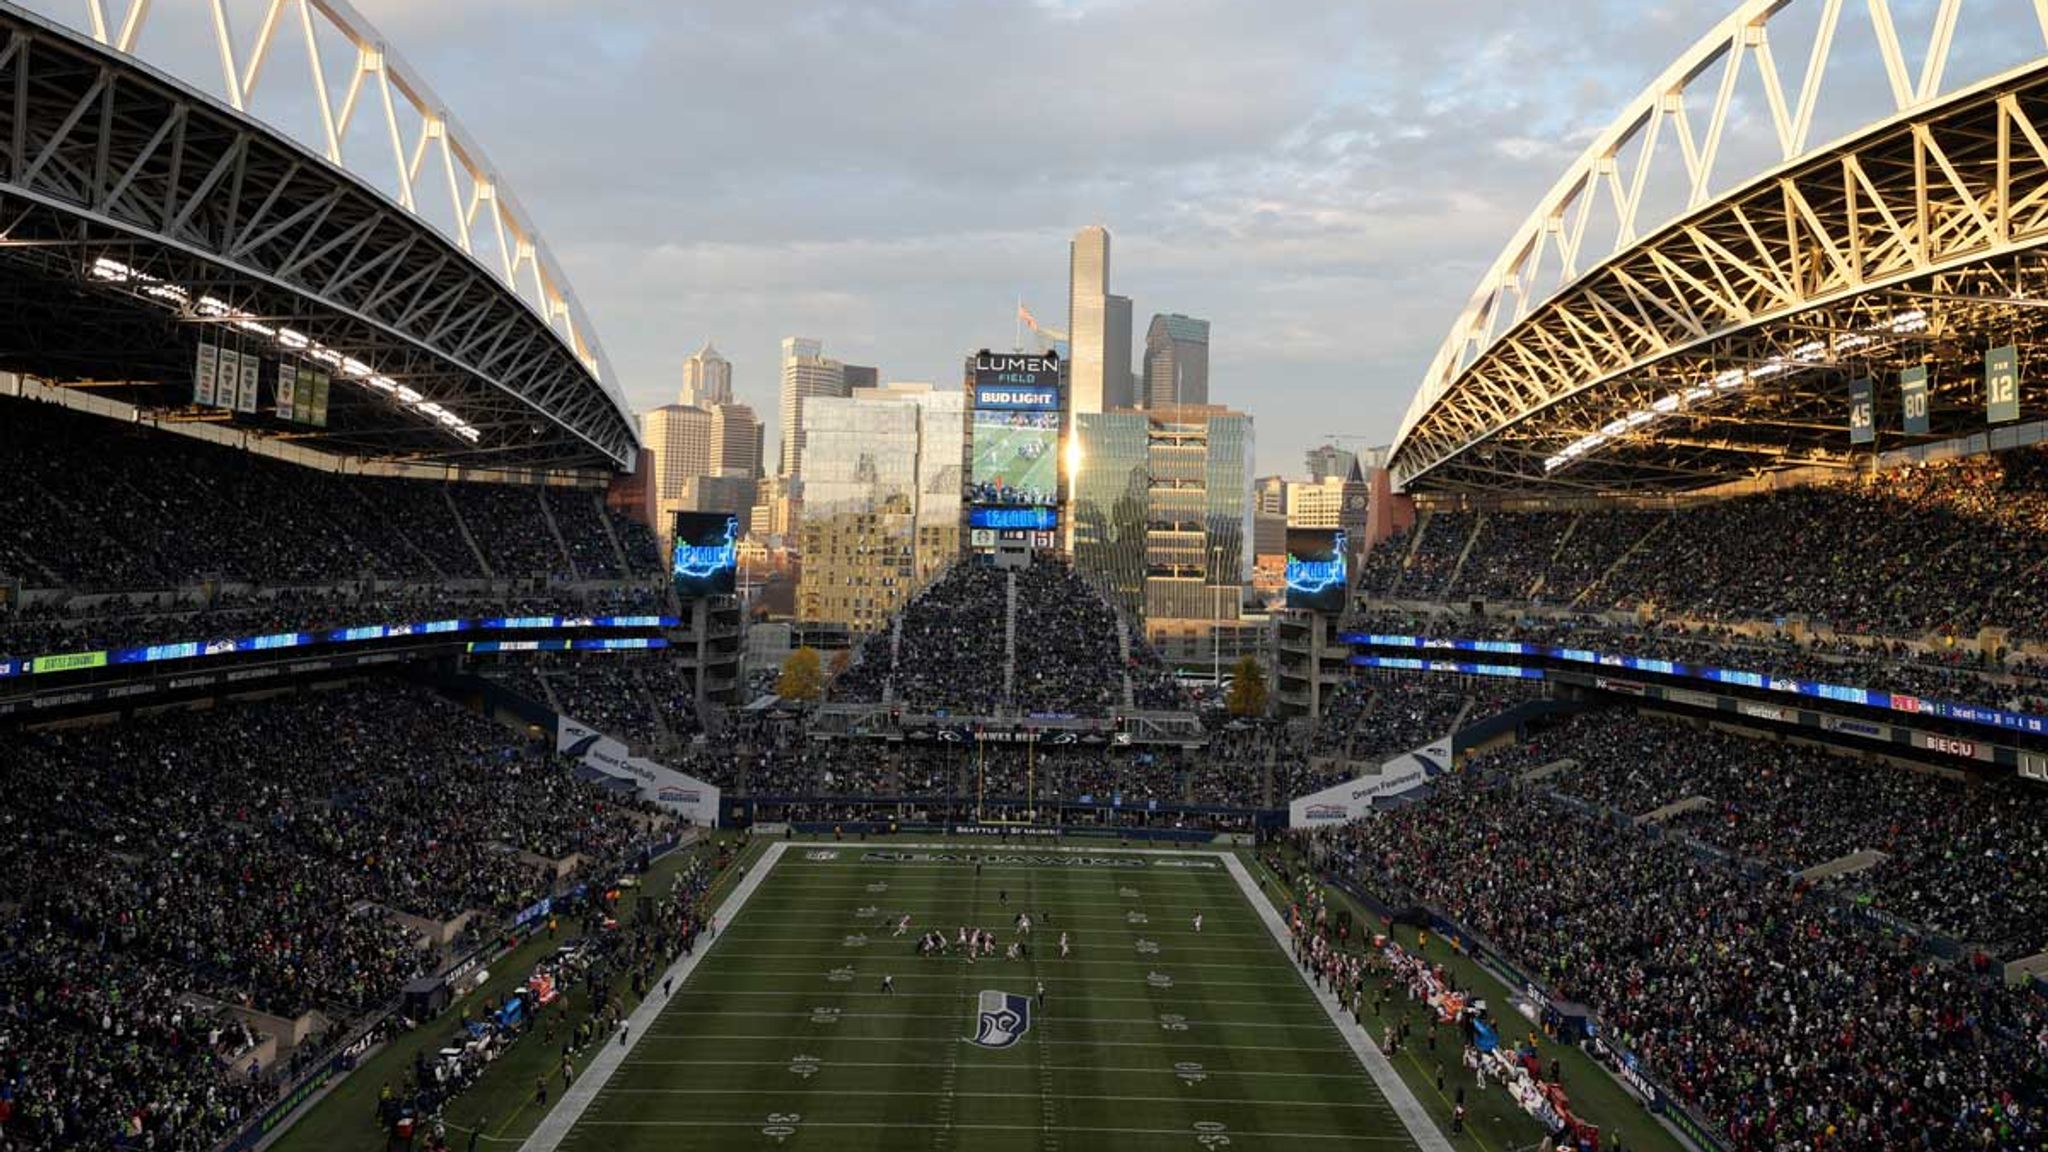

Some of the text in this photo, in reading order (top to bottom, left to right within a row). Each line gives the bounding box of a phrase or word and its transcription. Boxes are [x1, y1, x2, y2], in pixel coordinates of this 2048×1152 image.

[976, 357, 1058, 372] LUMEN
[998, 374, 1036, 383] FIELD
[1991, 374, 2013, 403] 12
[981, 392, 1052, 403] BUD LIGHT
[1904, 392, 1925, 419] 80
[1851, 403, 1871, 428] 45
[1352, 784, 1380, 800] Dream
